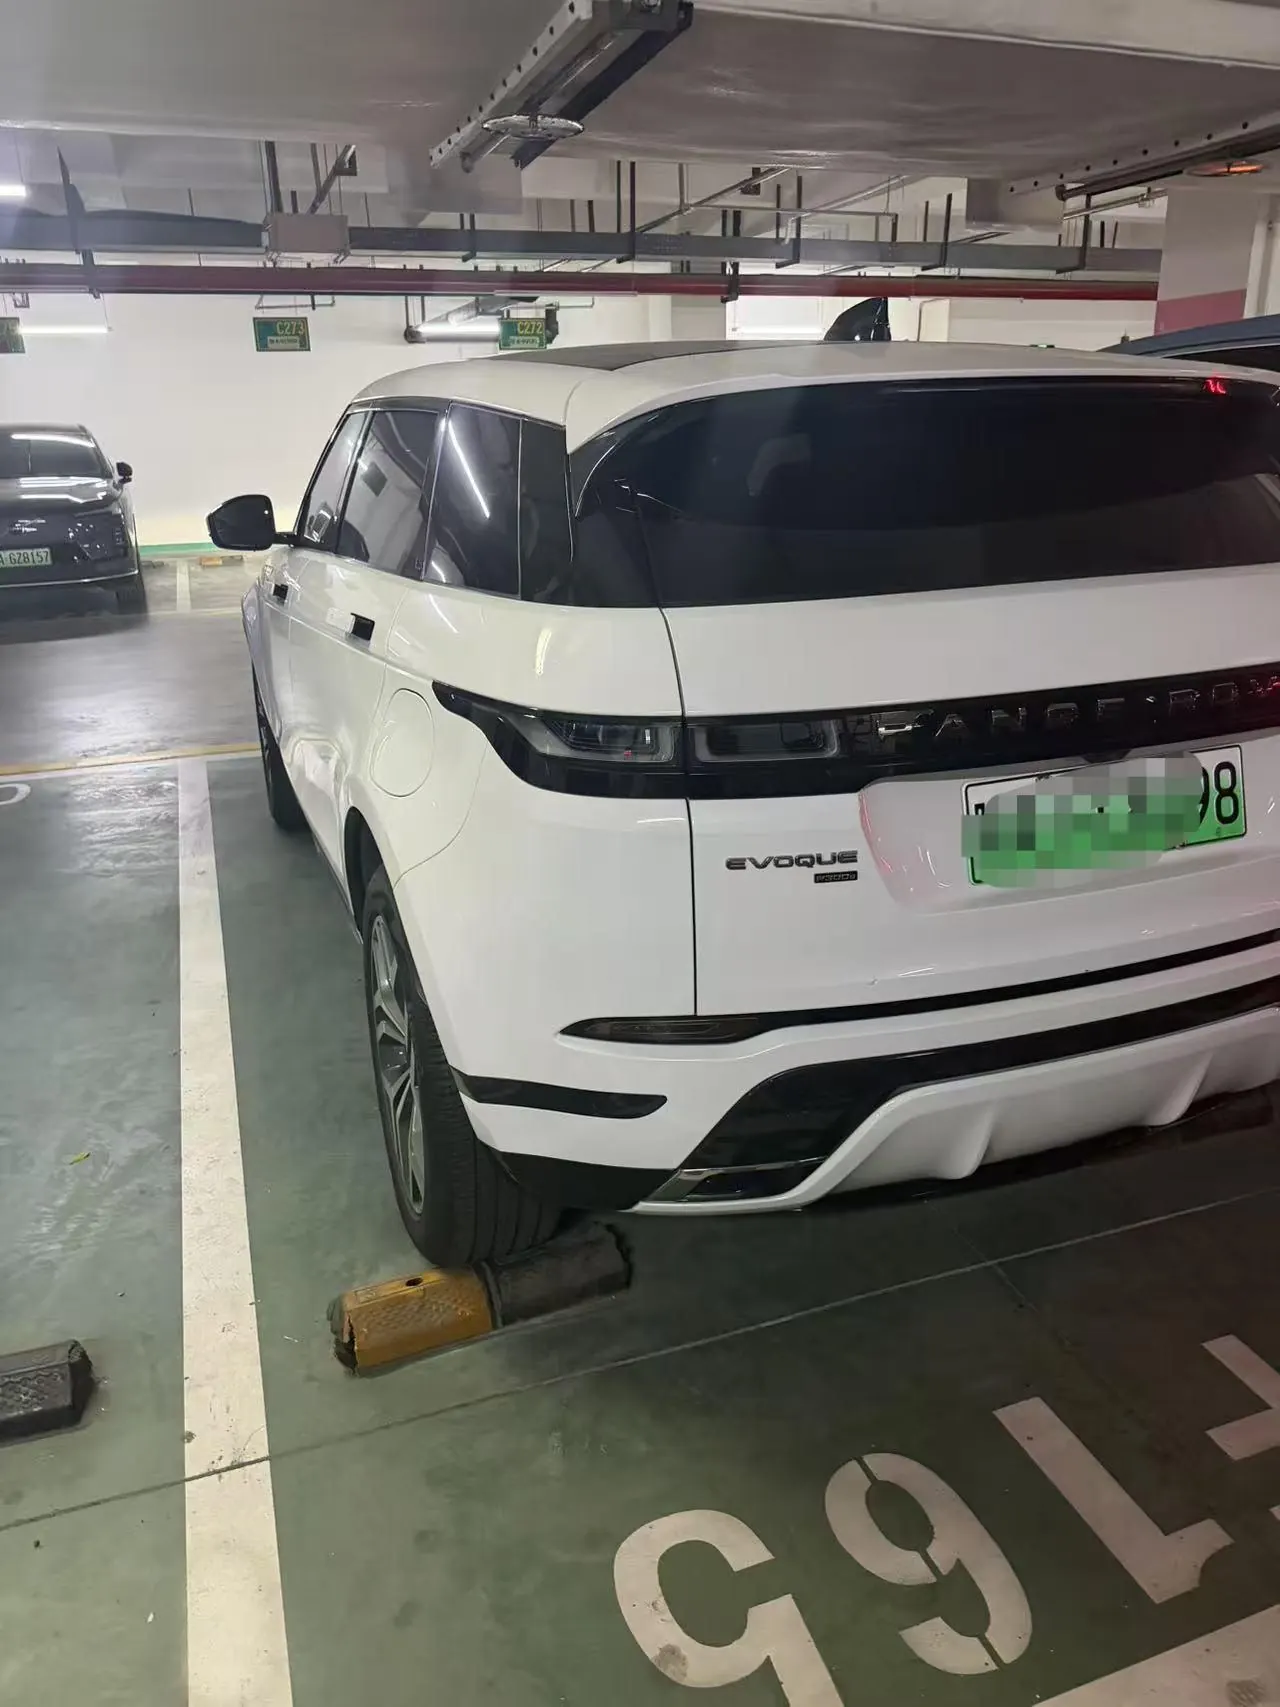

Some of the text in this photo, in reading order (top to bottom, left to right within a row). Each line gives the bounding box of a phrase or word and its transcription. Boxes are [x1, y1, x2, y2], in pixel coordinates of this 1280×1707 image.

[276, 321, 304, 335] C273
[518, 321, 543, 335] C272
[725, 850, 858, 870] EVOQUE
